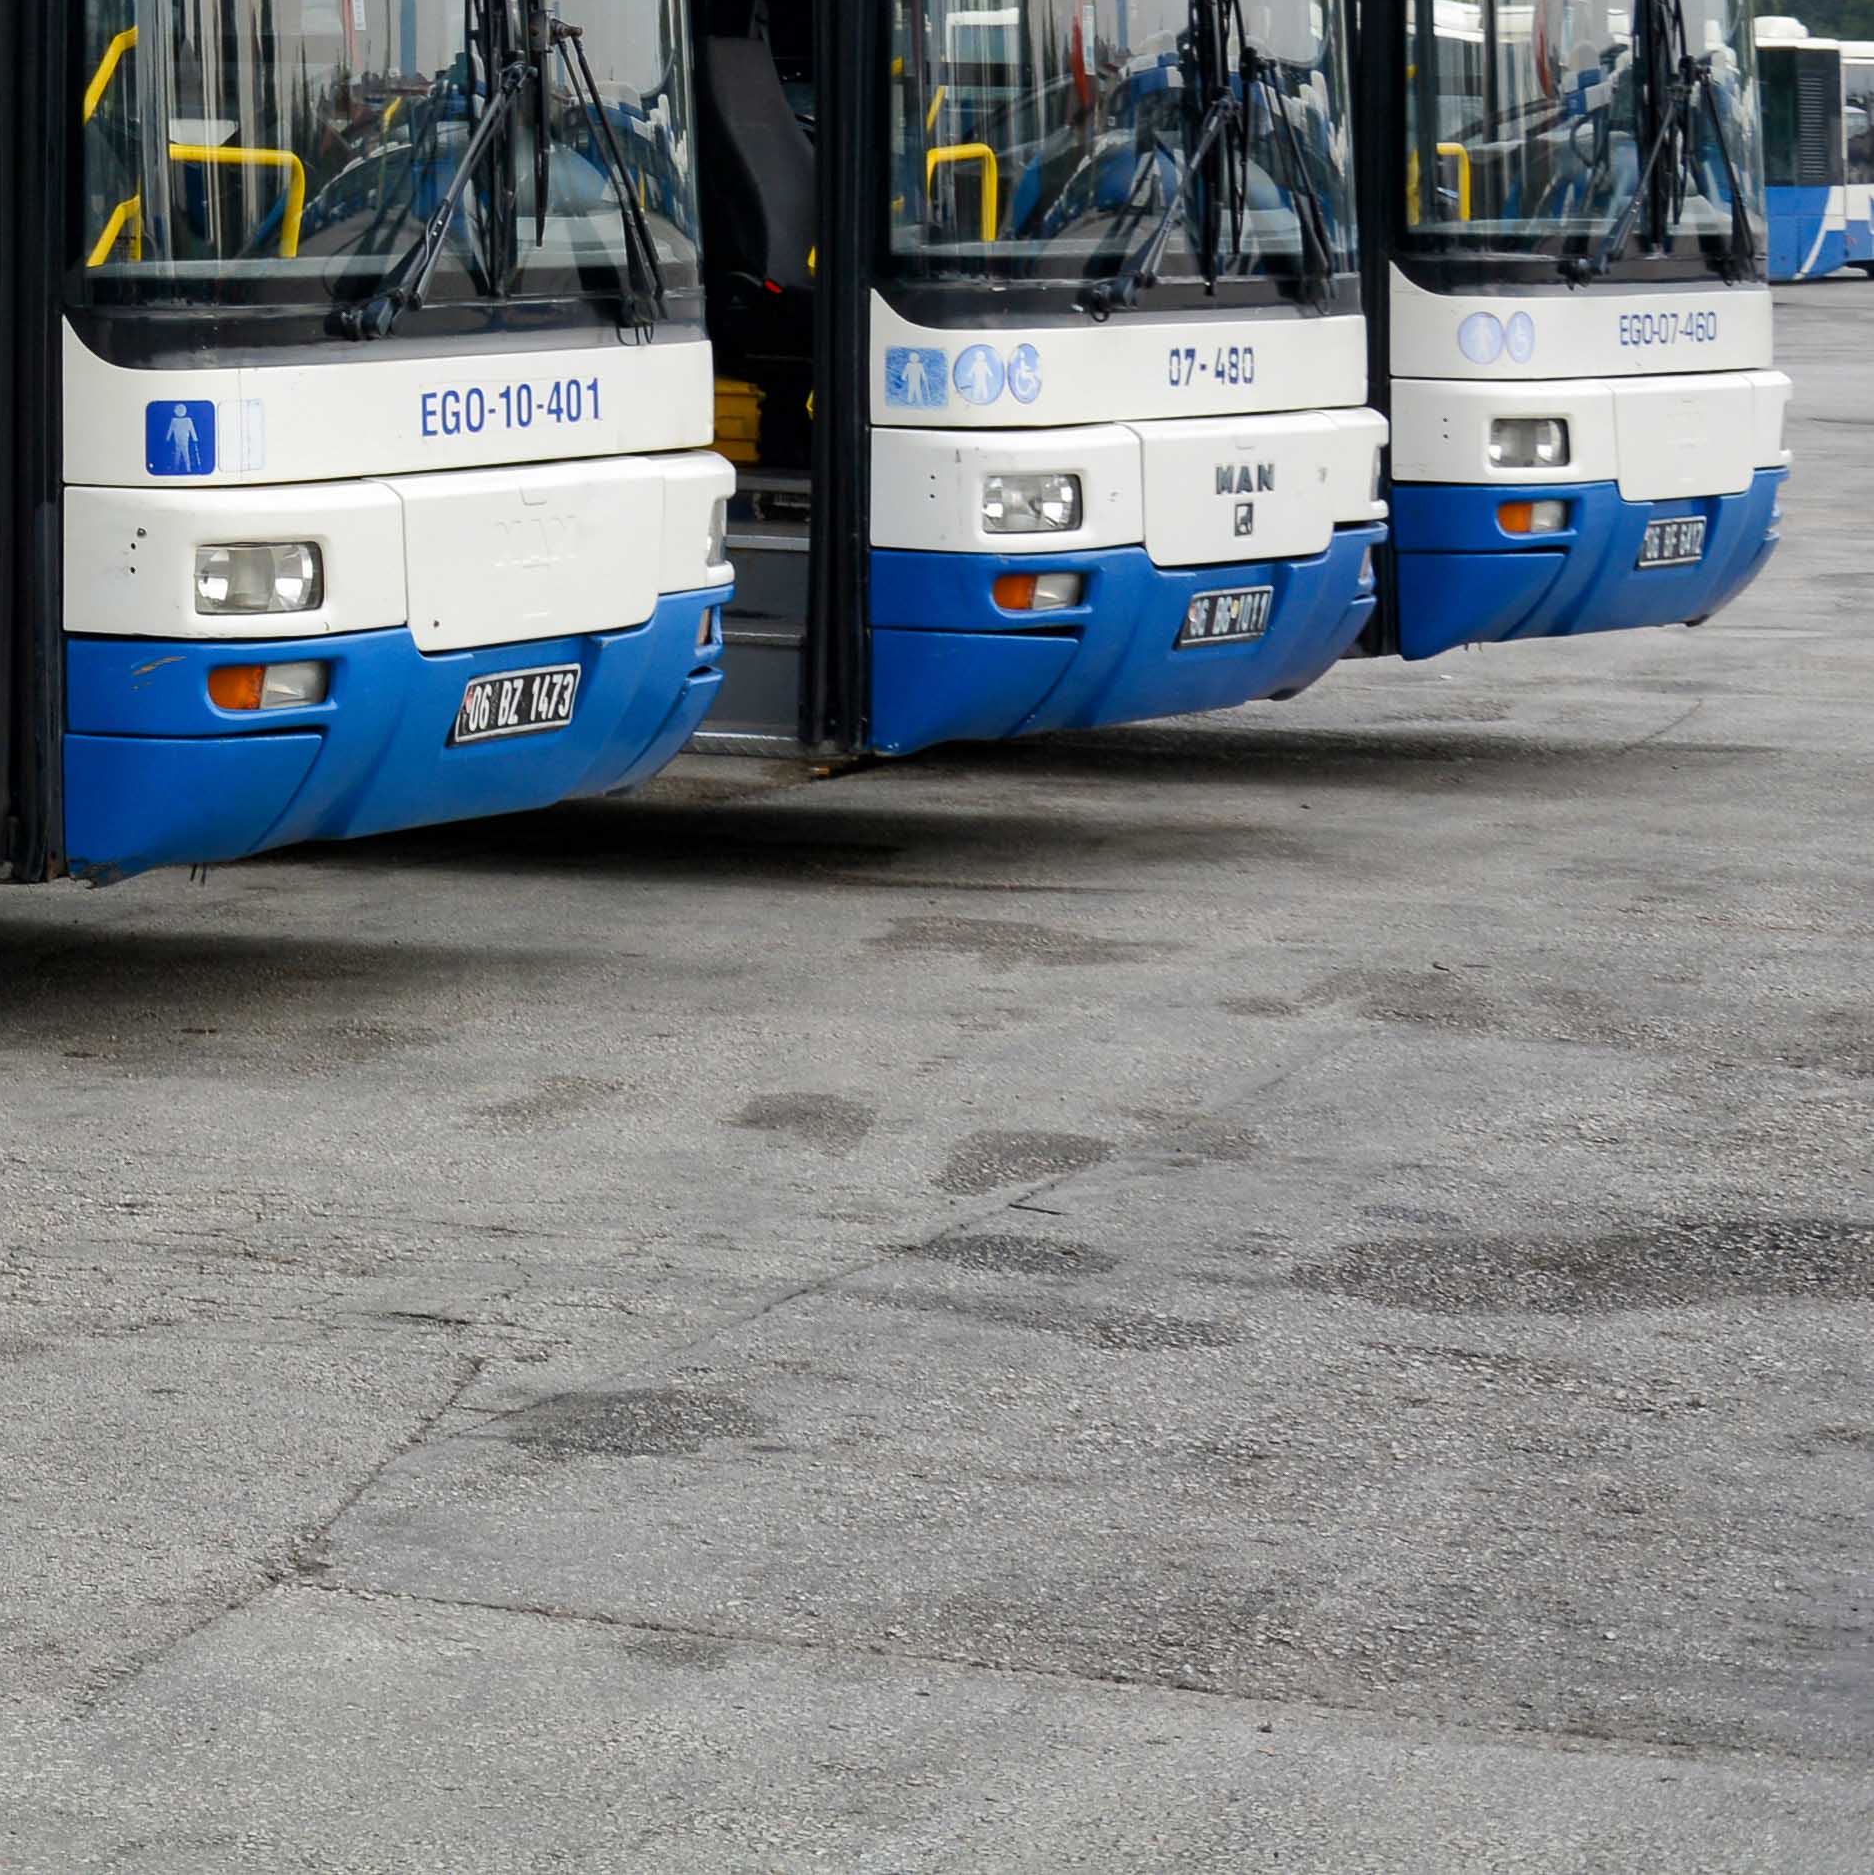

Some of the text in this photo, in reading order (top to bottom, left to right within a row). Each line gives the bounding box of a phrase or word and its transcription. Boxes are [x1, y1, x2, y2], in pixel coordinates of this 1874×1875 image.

[1619, 311, 1718, 346] EGO-07-460
[420, 378, 602, 437] EGO-10-401
[1215, 463, 1276, 495] MAN
[469, 672, 574, 732] 06 BZ 1473
